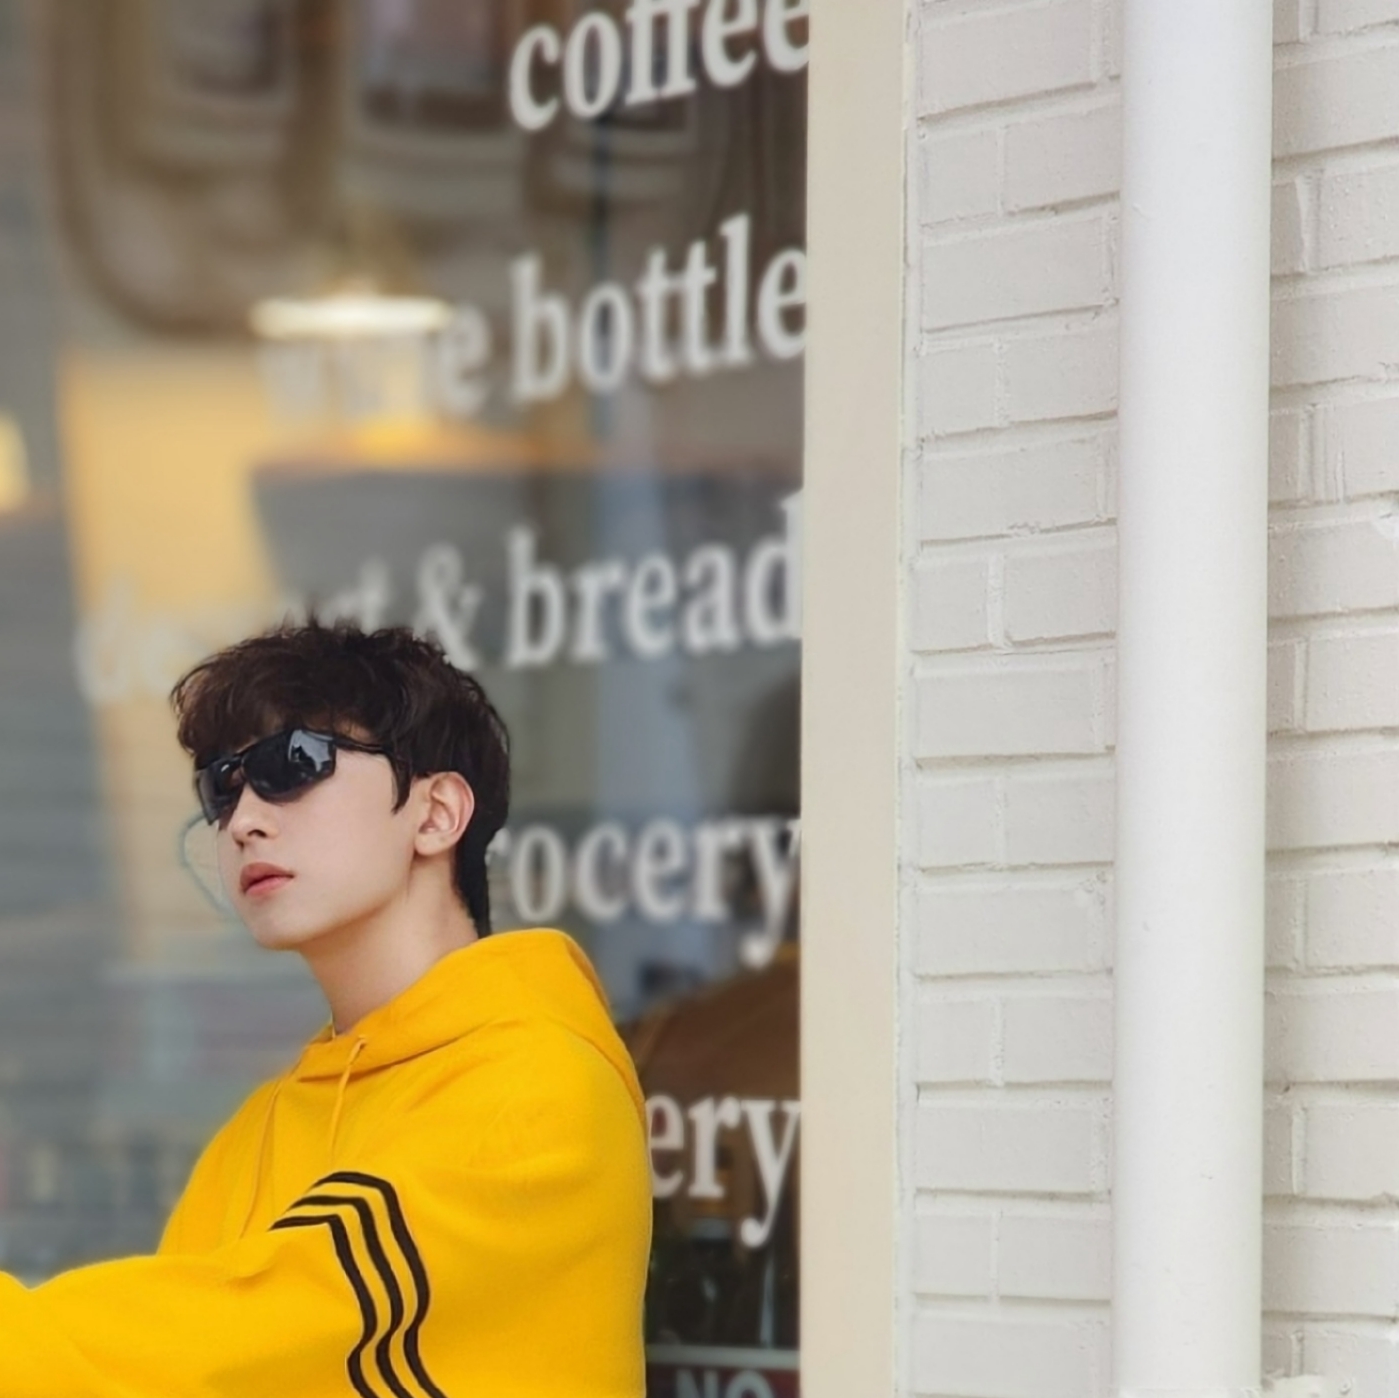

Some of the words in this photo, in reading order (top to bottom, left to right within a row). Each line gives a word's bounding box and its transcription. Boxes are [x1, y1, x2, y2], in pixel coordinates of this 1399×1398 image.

[509, 0, 808, 131] coffee
[511, 212, 806, 401] bottle
[416, 543, 482, 671] &
[507, 489, 802, 669] bread
[486, 814, 801, 967] ocery
[646, 1092, 801, 1247] ery
